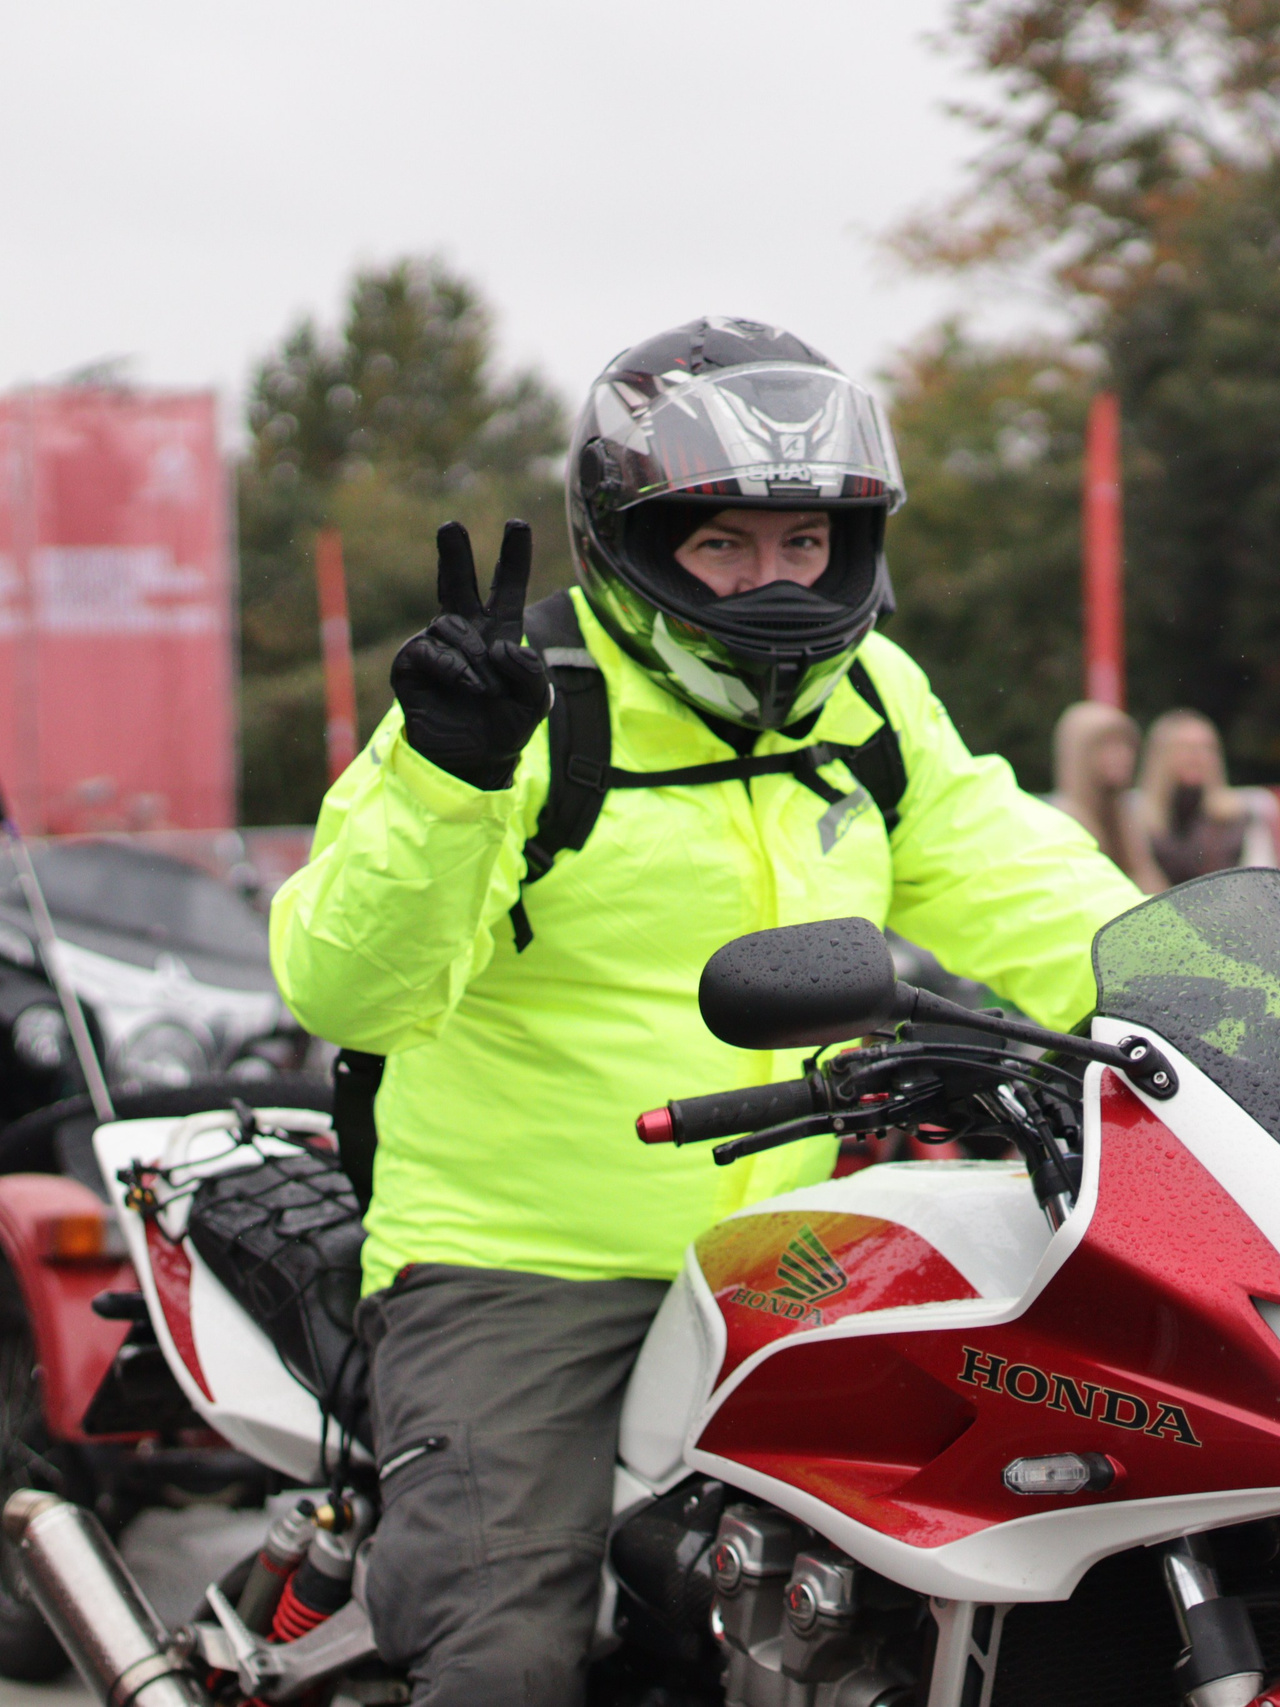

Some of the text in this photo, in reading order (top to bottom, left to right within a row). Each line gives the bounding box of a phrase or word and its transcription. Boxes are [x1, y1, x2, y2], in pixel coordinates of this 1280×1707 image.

[746, 463, 838, 482] SHA
[728, 1286, 825, 1327] HONDA
[957, 1345, 1202, 1447] HONDA
